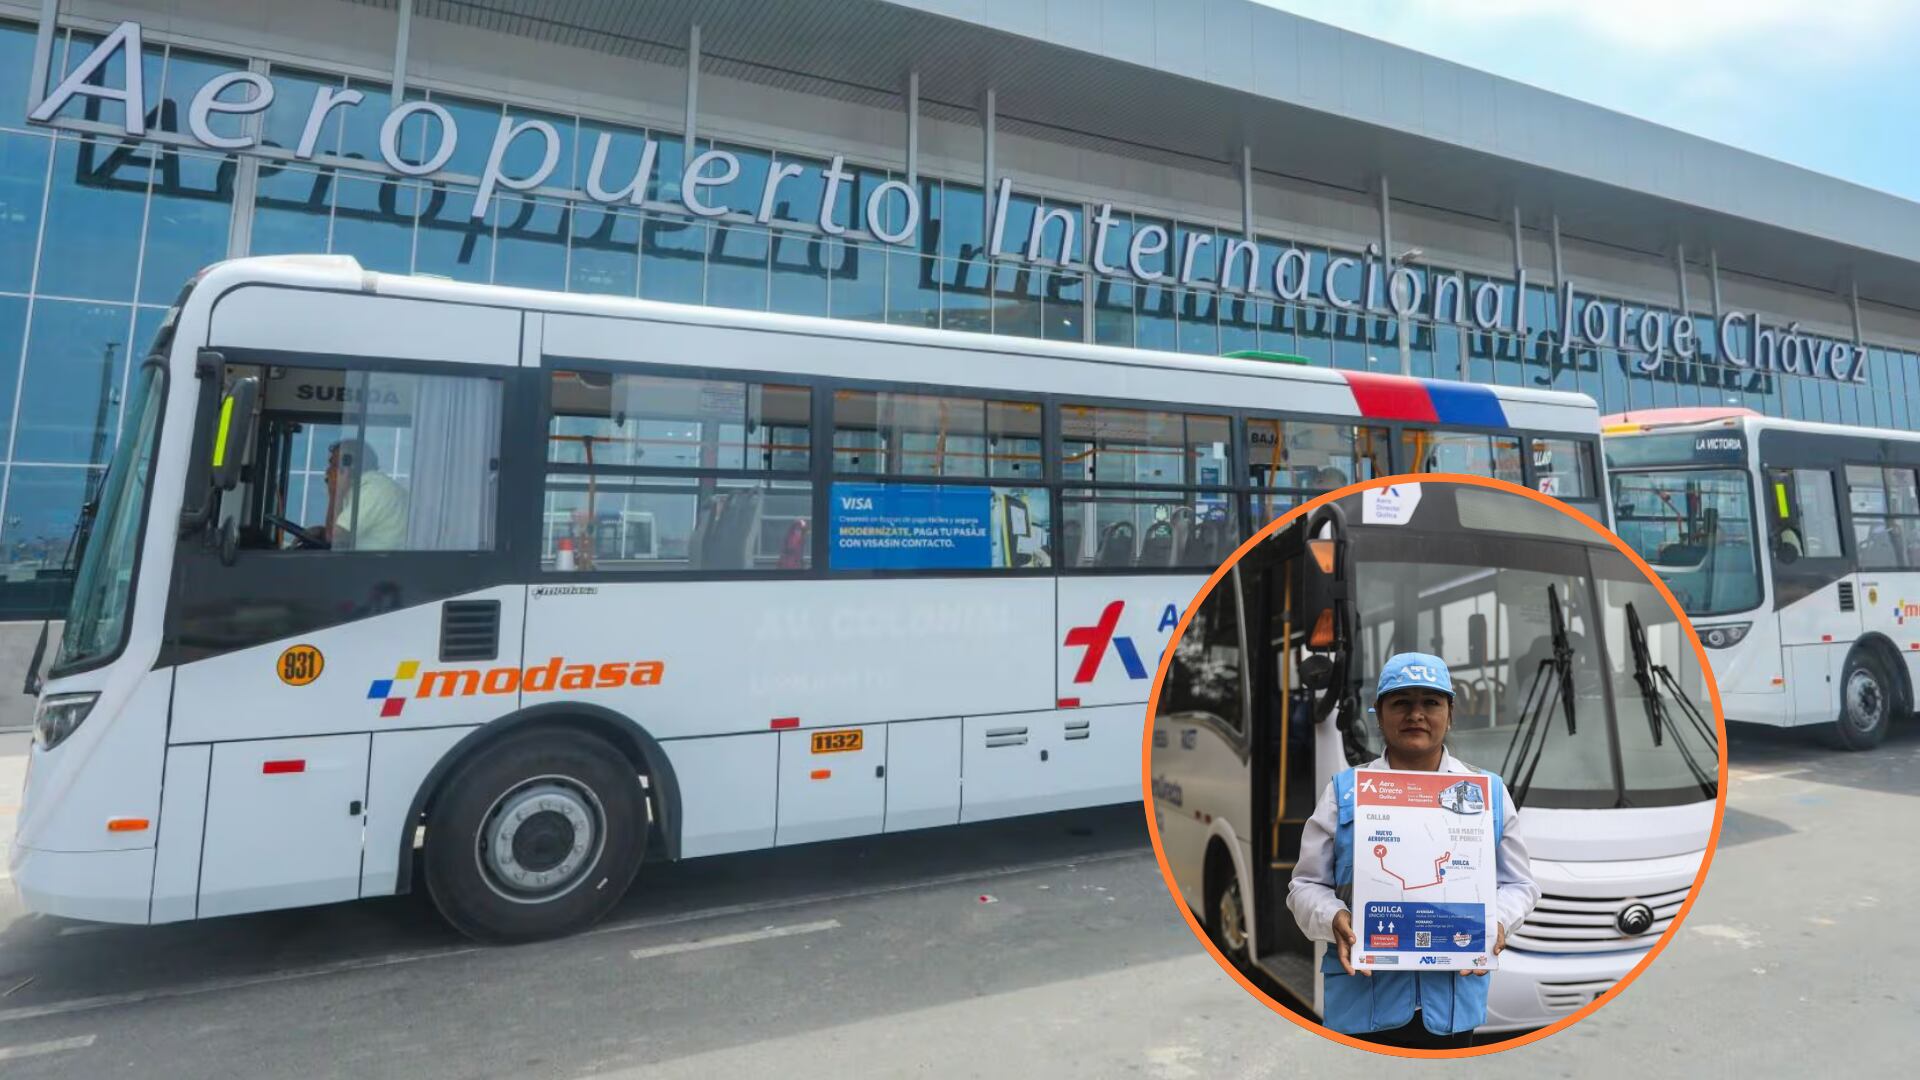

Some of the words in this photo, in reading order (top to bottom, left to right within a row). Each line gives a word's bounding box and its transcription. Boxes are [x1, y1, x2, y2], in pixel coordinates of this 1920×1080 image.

[27, 21, 919, 244] Aeropuerto
[990, 177, 1528, 335] Internacional
[1560, 280, 1694, 371] Jorge
[1718, 312, 1869, 382] Chávez
[296, 383, 400, 405] SUBIDA
[1695, 438, 1705, 450] LA
[841, 496, 873, 511] VISA
[913, 527, 939, 537] PAGA
[939, 527, 952, 537] TU
[953, 527, 986, 537] PASAJE
[839, 538, 861, 548] CON
[284, 652, 315, 679] 931
[415, 657, 664, 698] modasa
[1397, 665, 1438, 682] ATU
[815, 733, 860, 749] 1132
[1379, 787, 1403, 795] Directo
[1366, 813, 1391, 821] CALLAO
[1370, 905, 1402, 913] QUILCA
[1419, 956, 1436, 964] ATU
